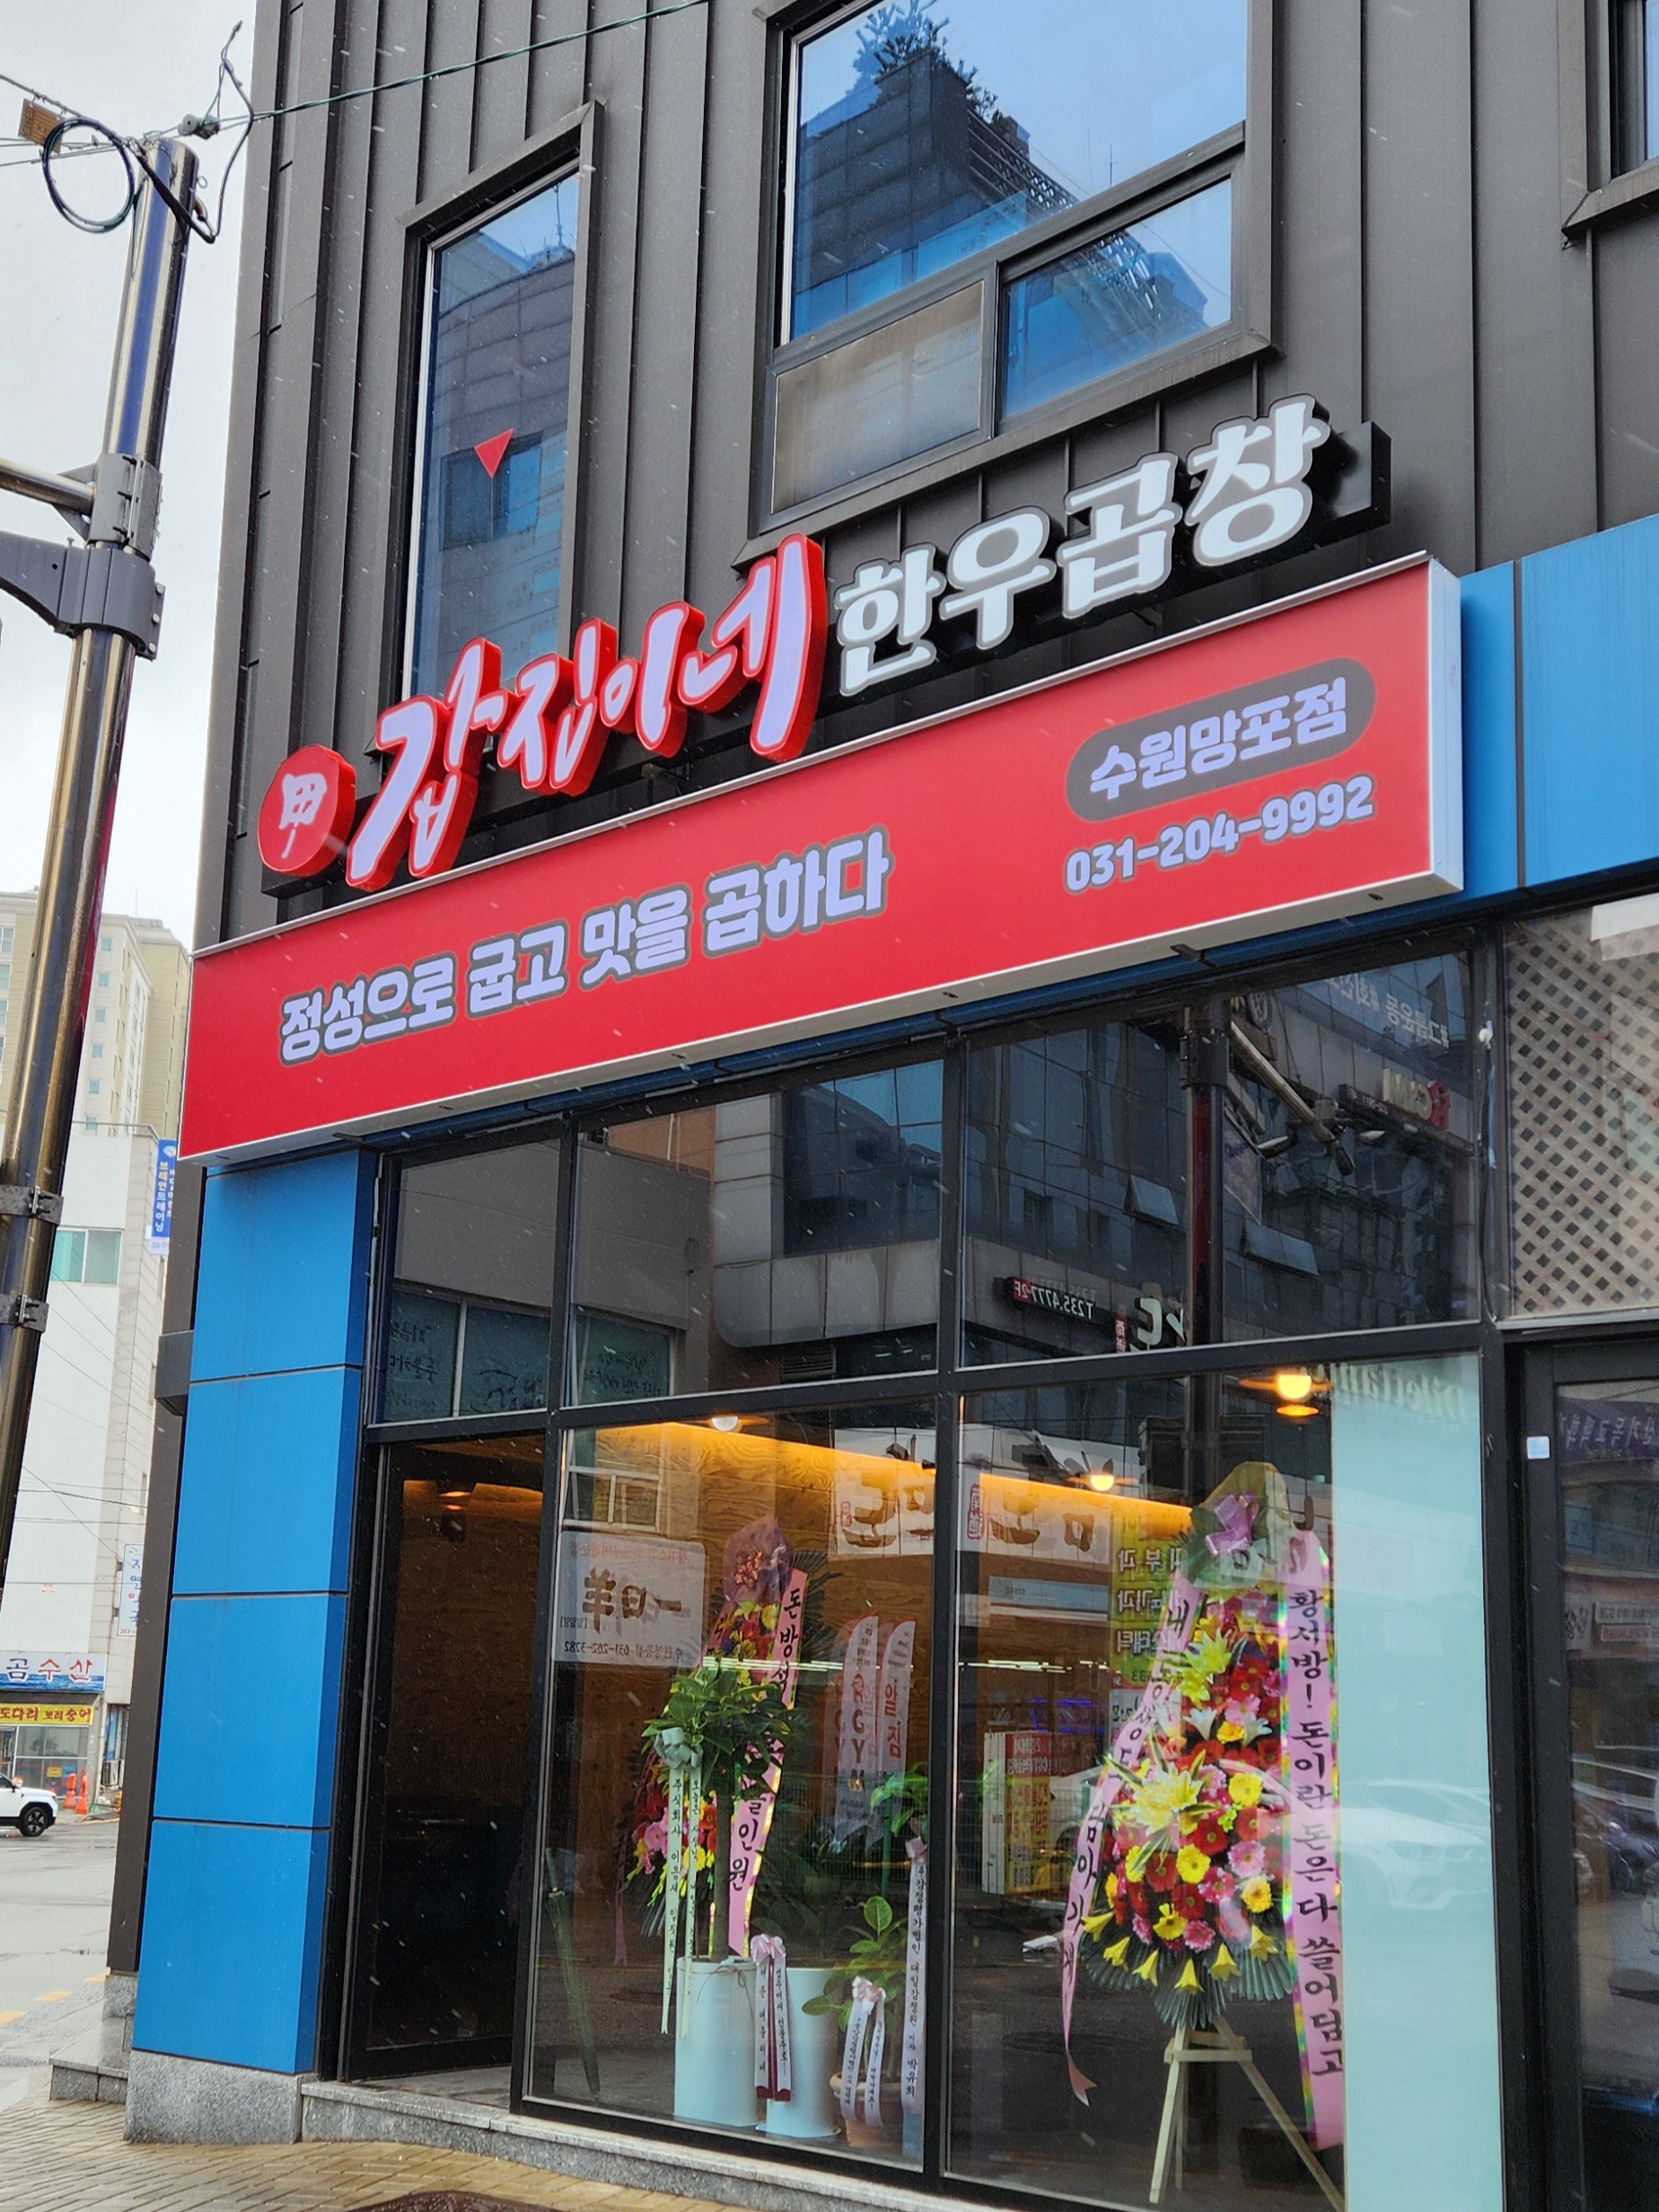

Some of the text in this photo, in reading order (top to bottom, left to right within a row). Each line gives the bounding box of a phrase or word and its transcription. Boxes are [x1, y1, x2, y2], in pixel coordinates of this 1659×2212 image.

[837, 396, 1329, 695] 한우곱창
[1090, 678, 1347, 800] 수원망포점
[1066, 777, 1374, 891] 031-204-9992
[281, 830, 890, 1064] 정성으로 굽고 맛을 곱하다
[1289, 1589, 1328, 1709] 황서방!
[0, 1707, 39, 1722] 도다리
[671, 1778, 682, 1839] 주식회사
[1289, 1721, 1330, 1811] 돈이란
[1293, 1823, 1335, 1883] 돈은
[1297, 1892, 1339, 1923] 다
